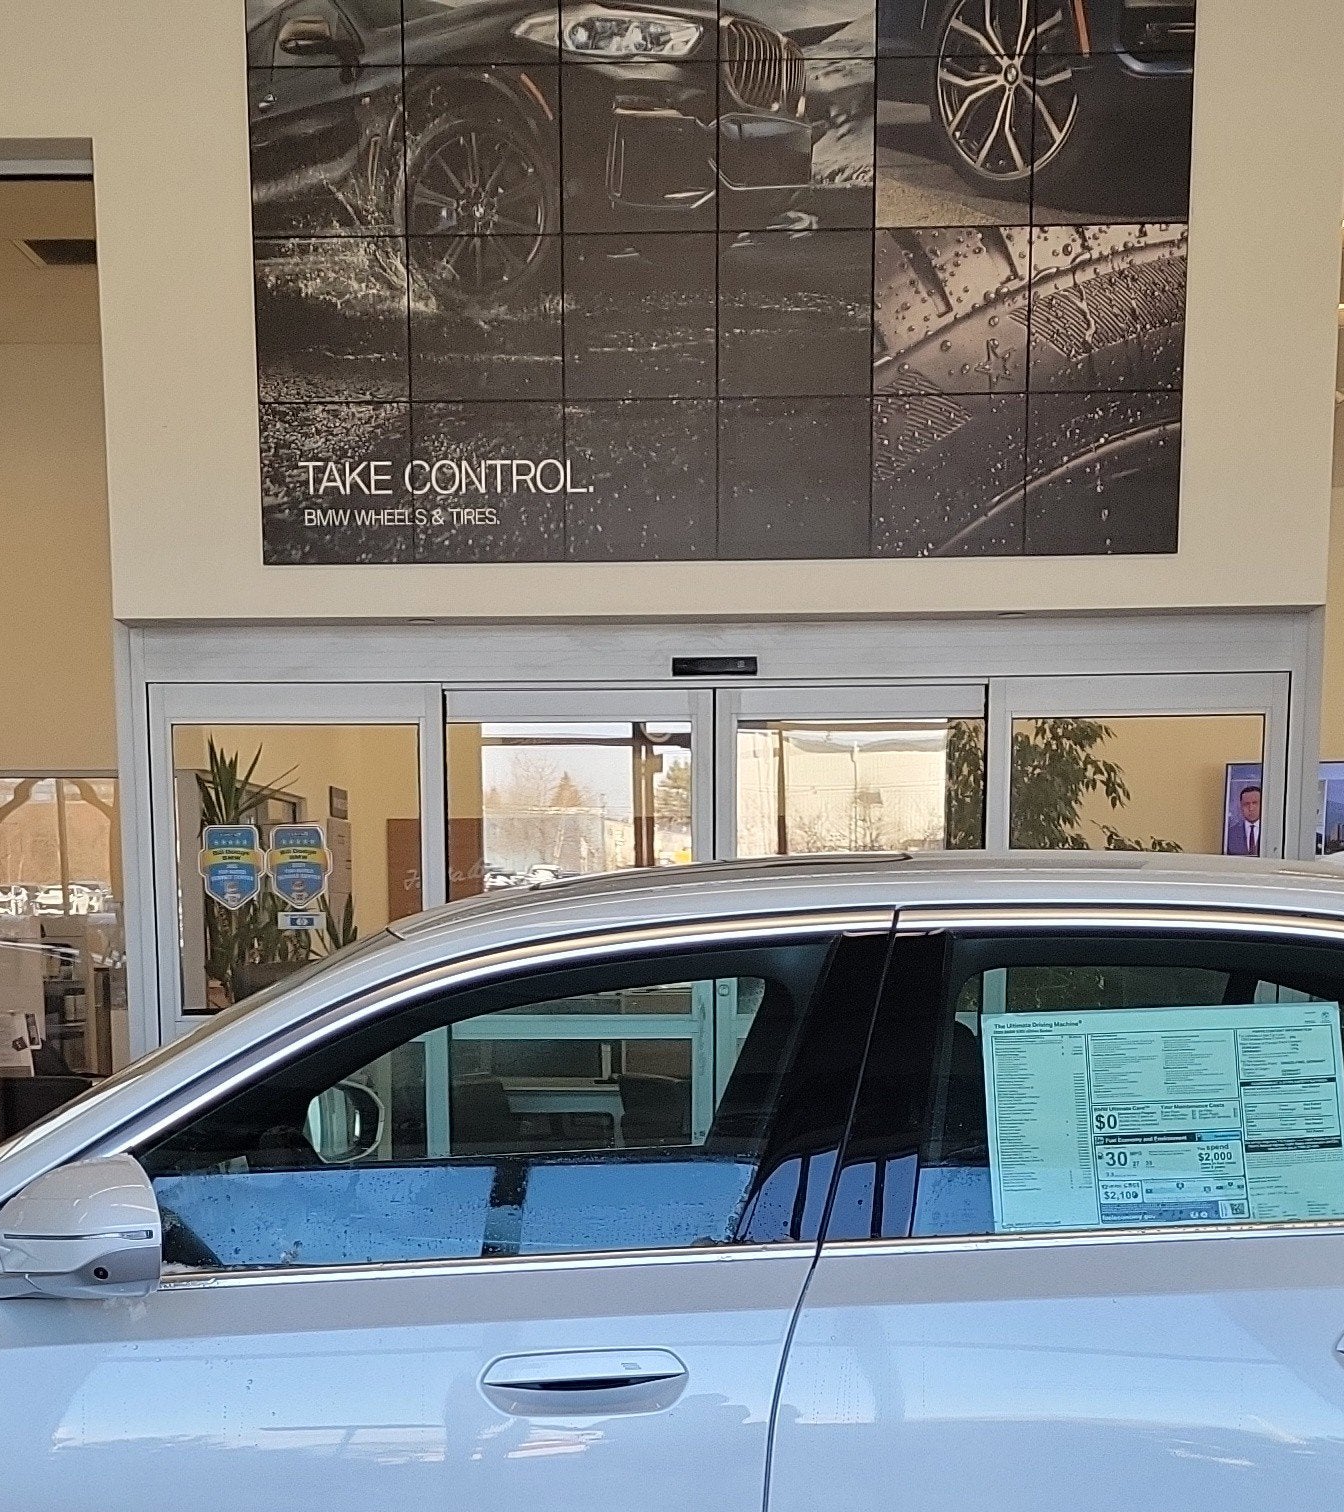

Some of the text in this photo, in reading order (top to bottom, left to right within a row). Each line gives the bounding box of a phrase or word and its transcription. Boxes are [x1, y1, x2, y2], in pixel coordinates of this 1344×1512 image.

[299, 458, 595, 495] TAKE CONTROL.
[304, 507, 501, 527] BMW WHEELS & TIRES.
[1032, 1021, 1053, 1029] Driving
[1094, 1113, 1117, 1131] $0
[1117, 1136, 1143, 1144] Economy
[1206, 1143, 1230, 1152] spend
[1105, 1151, 1128, 1167] 30
[1198, 1151, 1233, 1164] $2,000
